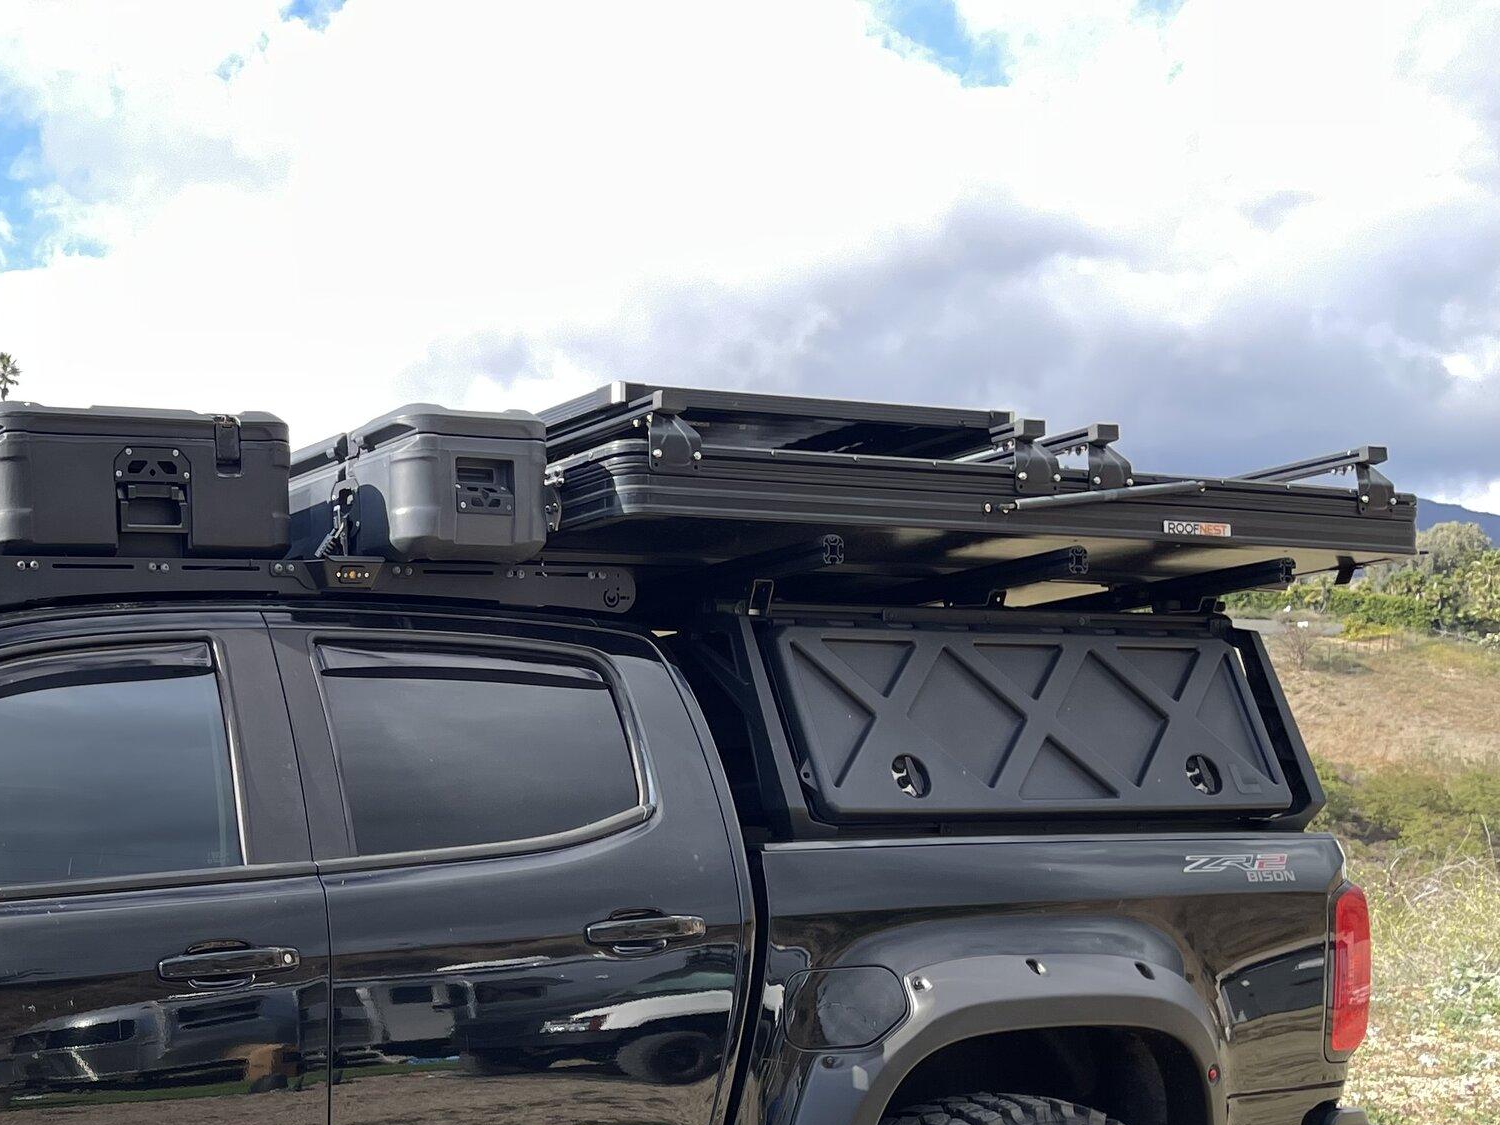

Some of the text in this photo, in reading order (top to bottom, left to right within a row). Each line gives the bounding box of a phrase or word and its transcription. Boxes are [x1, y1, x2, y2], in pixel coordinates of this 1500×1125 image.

[1167, 522, 1227, 536] ROOFNEST
[1183, 854, 1288, 873] ZR2
[1246, 871, 1296, 883] BISON
